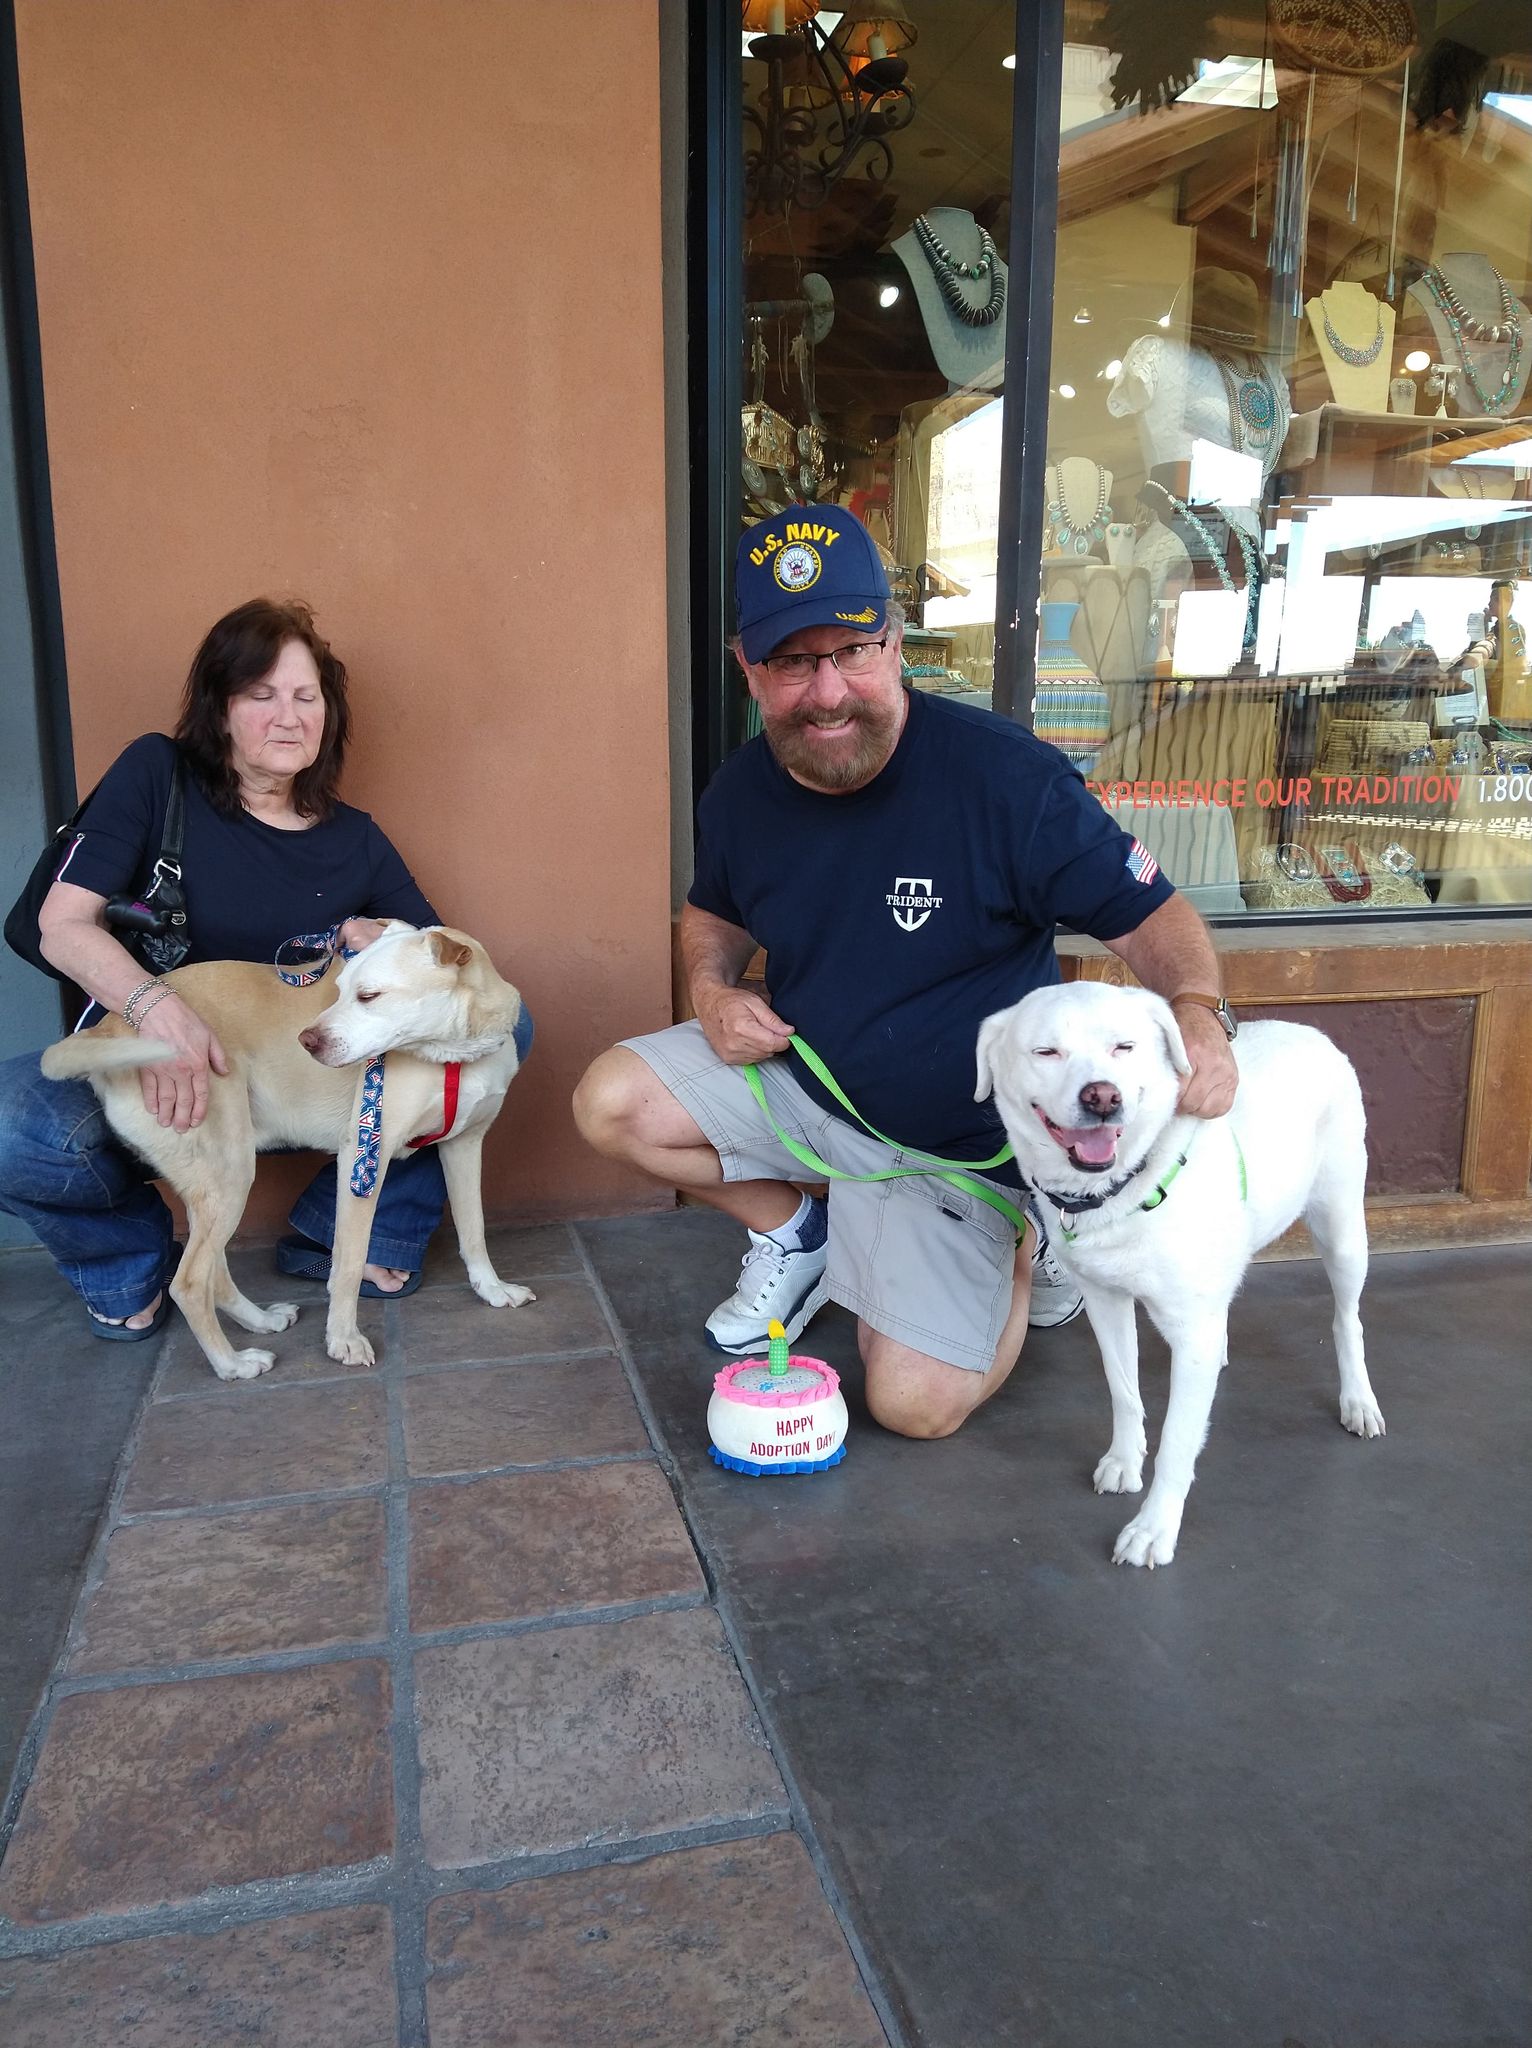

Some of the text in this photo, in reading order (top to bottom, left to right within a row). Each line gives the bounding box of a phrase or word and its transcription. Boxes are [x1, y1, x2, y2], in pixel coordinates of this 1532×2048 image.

[749, 522, 840, 566] U.S. NAVY
[1085, 779, 1247, 810] XPERIENCE
[1255, 778, 1312, 807] OUR
[1321, 774, 1462, 806] TRADITION
[885, 894, 943, 909] TRIDENT
[776, 1415, 814, 1437] HAPPY
[750, 1441, 810, 1457] ADOPTION
